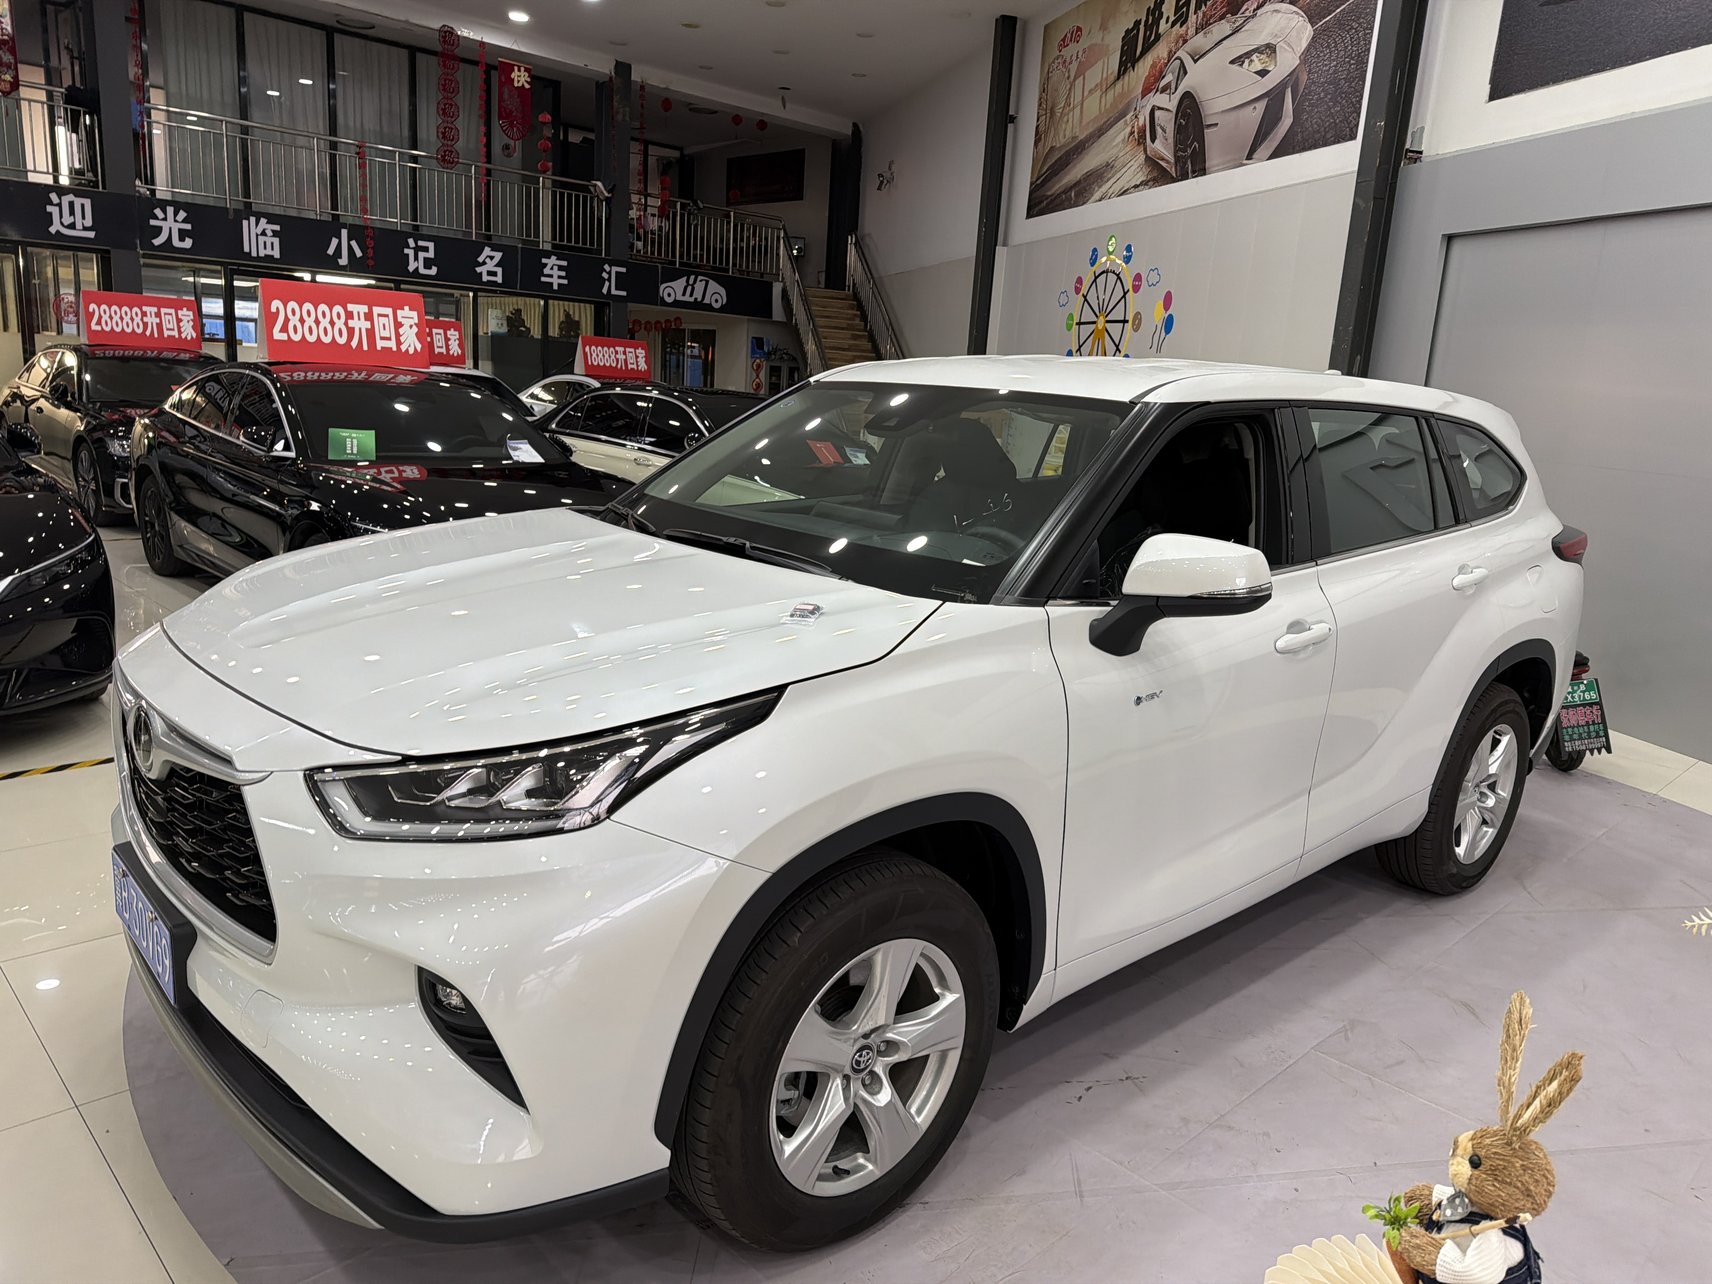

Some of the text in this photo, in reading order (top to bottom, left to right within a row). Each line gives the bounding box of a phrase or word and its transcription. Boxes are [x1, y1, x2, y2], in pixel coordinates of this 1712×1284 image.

[510, 65, 531, 89] 快
[88, 302, 197, 341] 28888开回家
[270, 298, 423, 355] 28888开回家
[426, 327, 462, 357] 回家
[584, 344, 649, 372] 18888开回家
